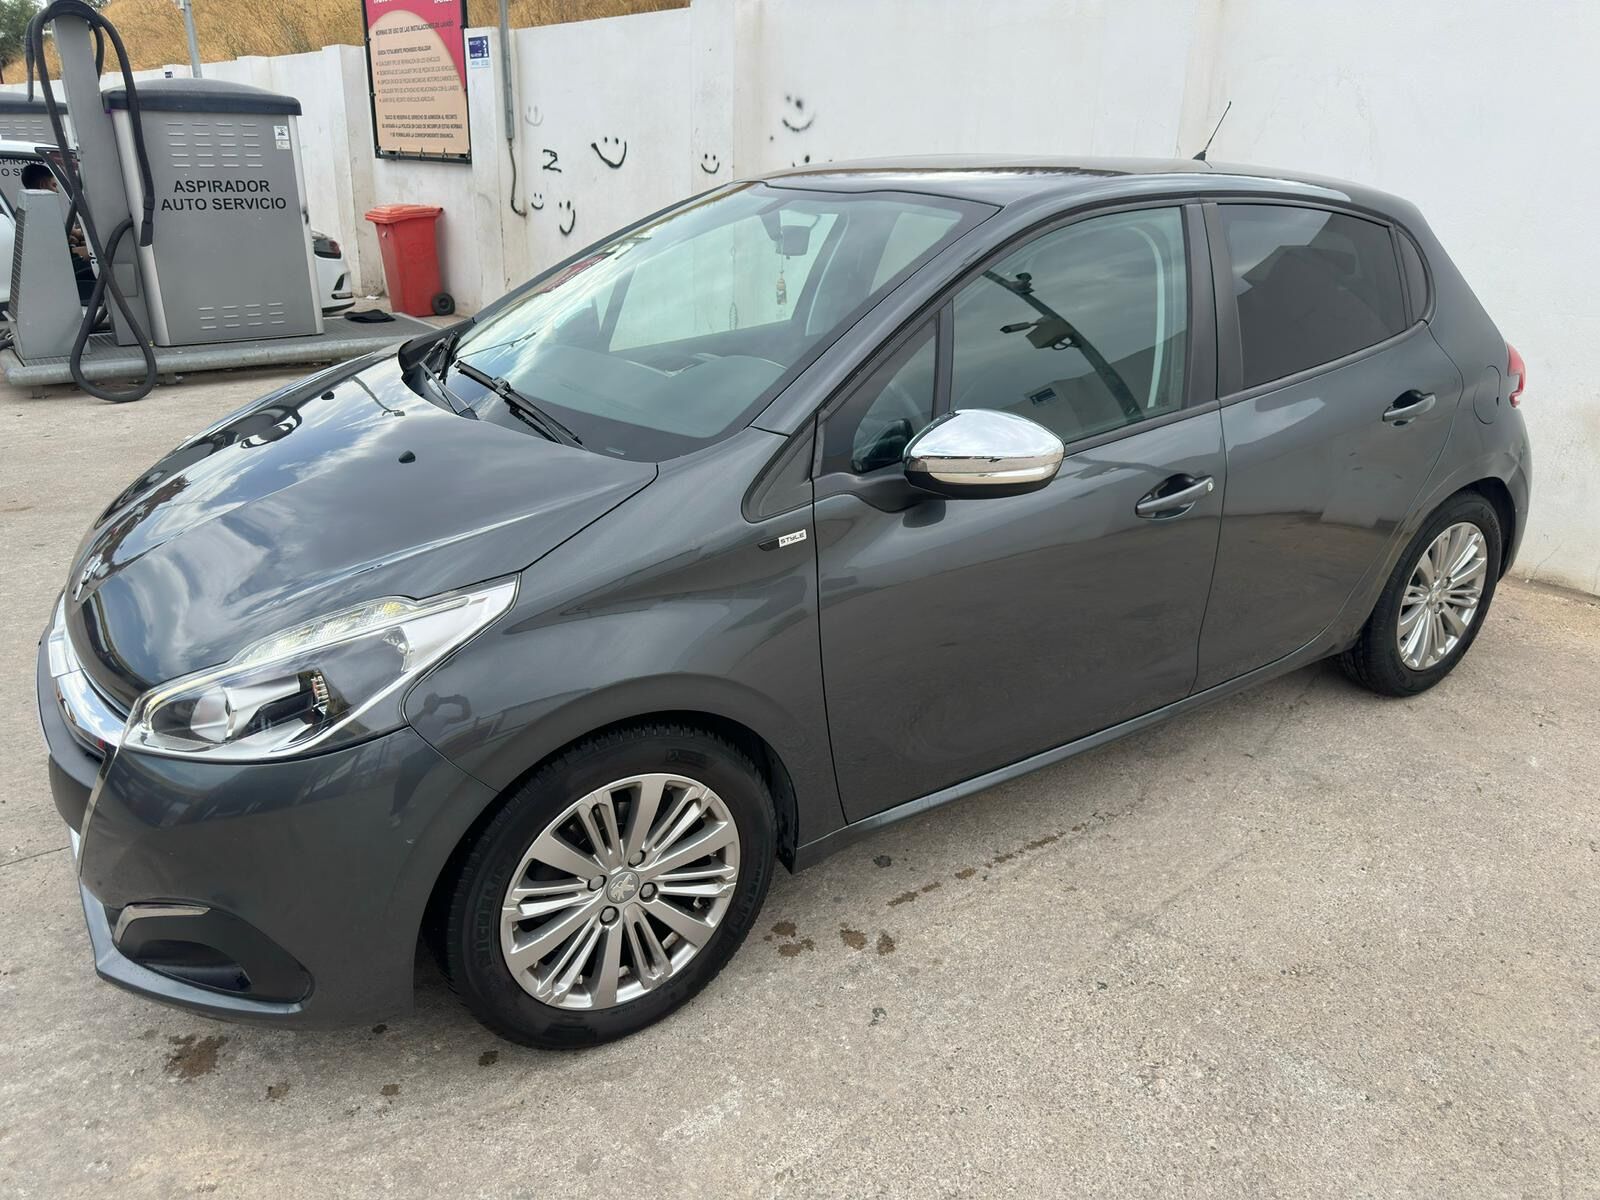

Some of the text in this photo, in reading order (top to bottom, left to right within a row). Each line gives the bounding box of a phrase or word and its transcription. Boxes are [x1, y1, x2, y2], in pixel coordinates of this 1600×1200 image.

[174, 180, 270, 192] ASPIRADOR
[161, 198, 286, 210] AUTO SERVICIO
[780, 532, 804, 544] STYLE
